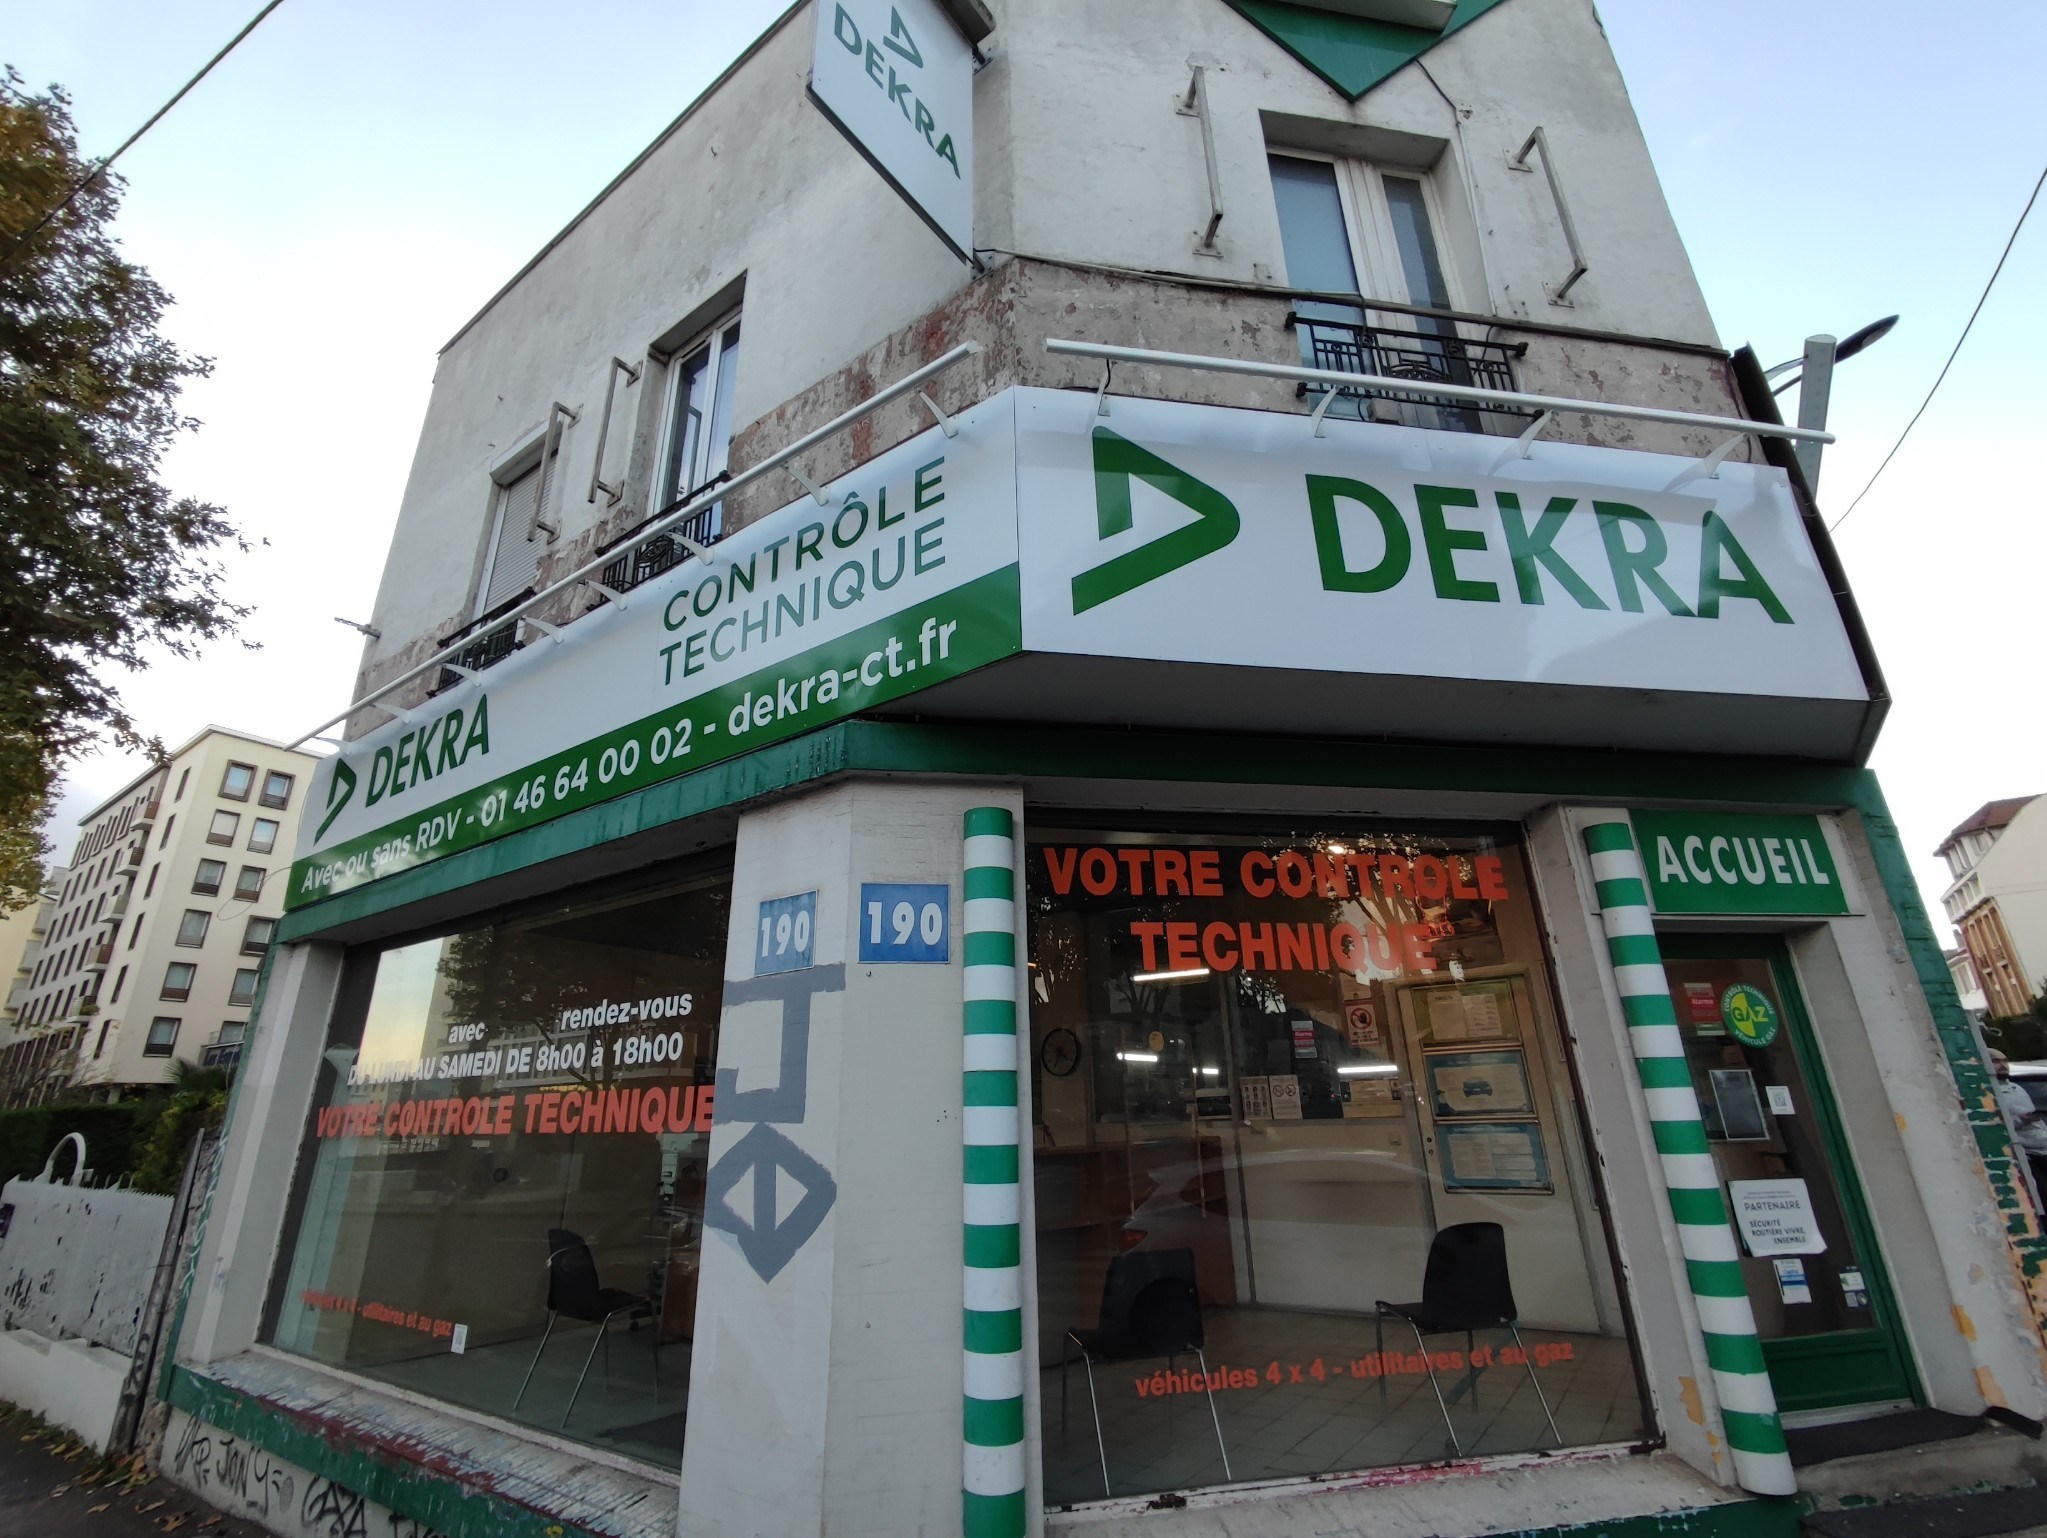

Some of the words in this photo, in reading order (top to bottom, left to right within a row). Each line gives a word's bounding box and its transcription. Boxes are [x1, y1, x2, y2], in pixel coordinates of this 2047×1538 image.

[834, 2, 961, 180] DEKRA
[664, 456, 945, 631] CONTRÔLE
[1305, 473, 1795, 624] DEKRA
[659, 517, 946, 686] TECHNIQUE
[301, 859, 342, 894] Avec
[344, 854, 365, 879] ou
[371, 833, 411, 868] sans
[415, 808, 462, 851] RDV
[481, 789, 508, 828] 01
[513, 774, 546, 814] 46
[553, 757, 588, 801] 64
[597, 739, 641, 784] 00
[650, 718, 693, 765] 02
[727, 617, 958, 736] dekra-ct.fr
[365, 693, 490, 808] DEKRA
[1043, 847, 1223, 896] VOTRE
[1240, 850, 1508, 900] CONTROLE
[1656, 835, 1830, 885] ACCUEIL
[760, 909, 810, 958] 190
[867, 901, 943, 947] 190
[1130, 920, 1438, 972] TECHNIQUE
[448, 1022, 486, 1044] avec
[560, 993, 693, 1031] rendez-vous
[1732, 1006, 1769, 1022] GAZ
[413, 1057, 436, 1081] AU
[437, 1049, 503, 1079] SAMEDI
[505, 1048, 531, 1074] DE
[536, 1042, 586, 1072] 8h00
[591, 1040, 604, 1068] à
[612, 1031, 684, 1066] 18h00
[317, 1103, 381, 1138] VOTRE
[383, 1095, 515, 1136] CONTROLE
[525, 1085, 715, 1136] TECHNIQUE
[1743, 1200, 1801, 1211] PARTENAIRE
[406, 1311, 417, 1329] et
[418, 1315, 432, 1332] au
[433, 1318, 453, 1338] gaz
[1135, 1365, 1258, 1397] véhicules
[1265, 1362, 1281, 1384] 4
[1310, 1358, 1326, 1381] 4
[1350, 1350, 1464, 1379] utilitaires
[1469, 1346, 1494, 1368] et
[1500, 1346, 1528, 1367] au
[1534, 1341, 1575, 1368] gaz
